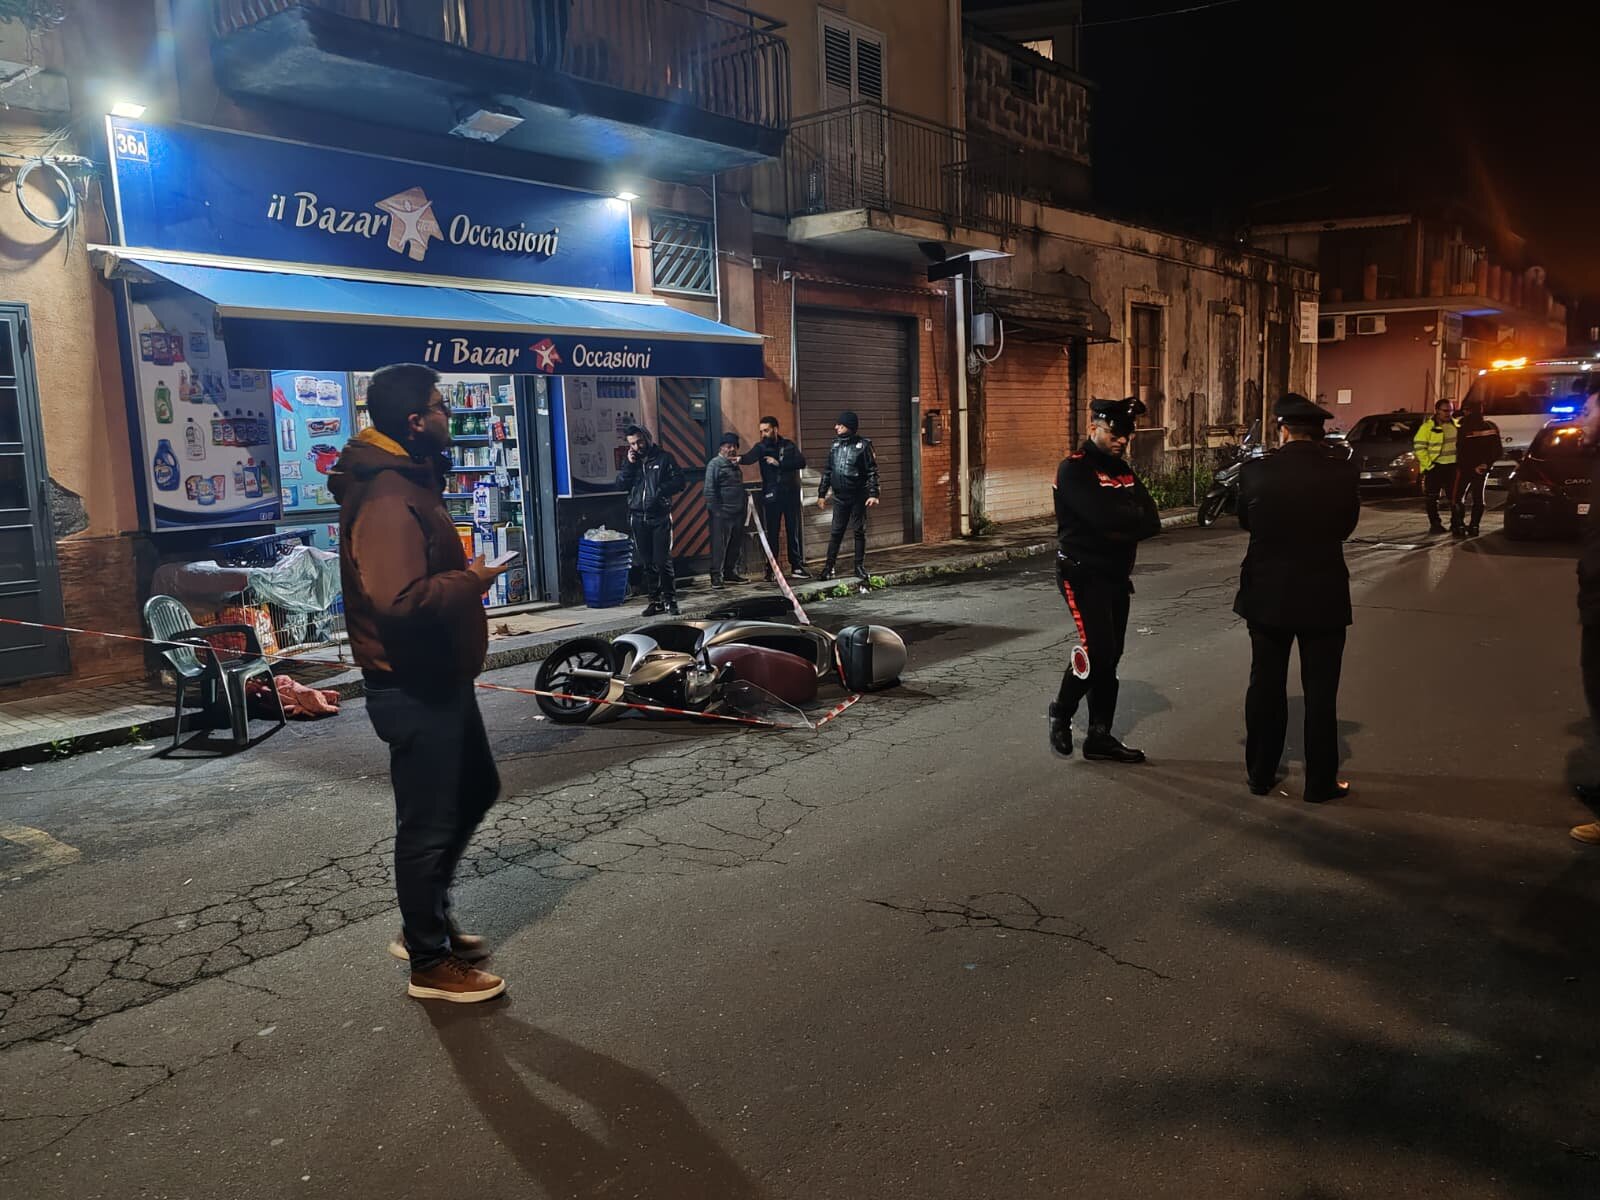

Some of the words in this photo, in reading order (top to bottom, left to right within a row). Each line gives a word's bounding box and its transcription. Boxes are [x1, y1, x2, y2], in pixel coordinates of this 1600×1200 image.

[116, 133, 147, 157] 36A
[267, 193, 286, 220] il
[294, 191, 389, 239] Bazar
[449, 214, 560, 256] Occasioni
[424, 340, 442, 363] il
[450, 337, 520, 366] Bazar
[572, 343, 652, 369] Occasioni
